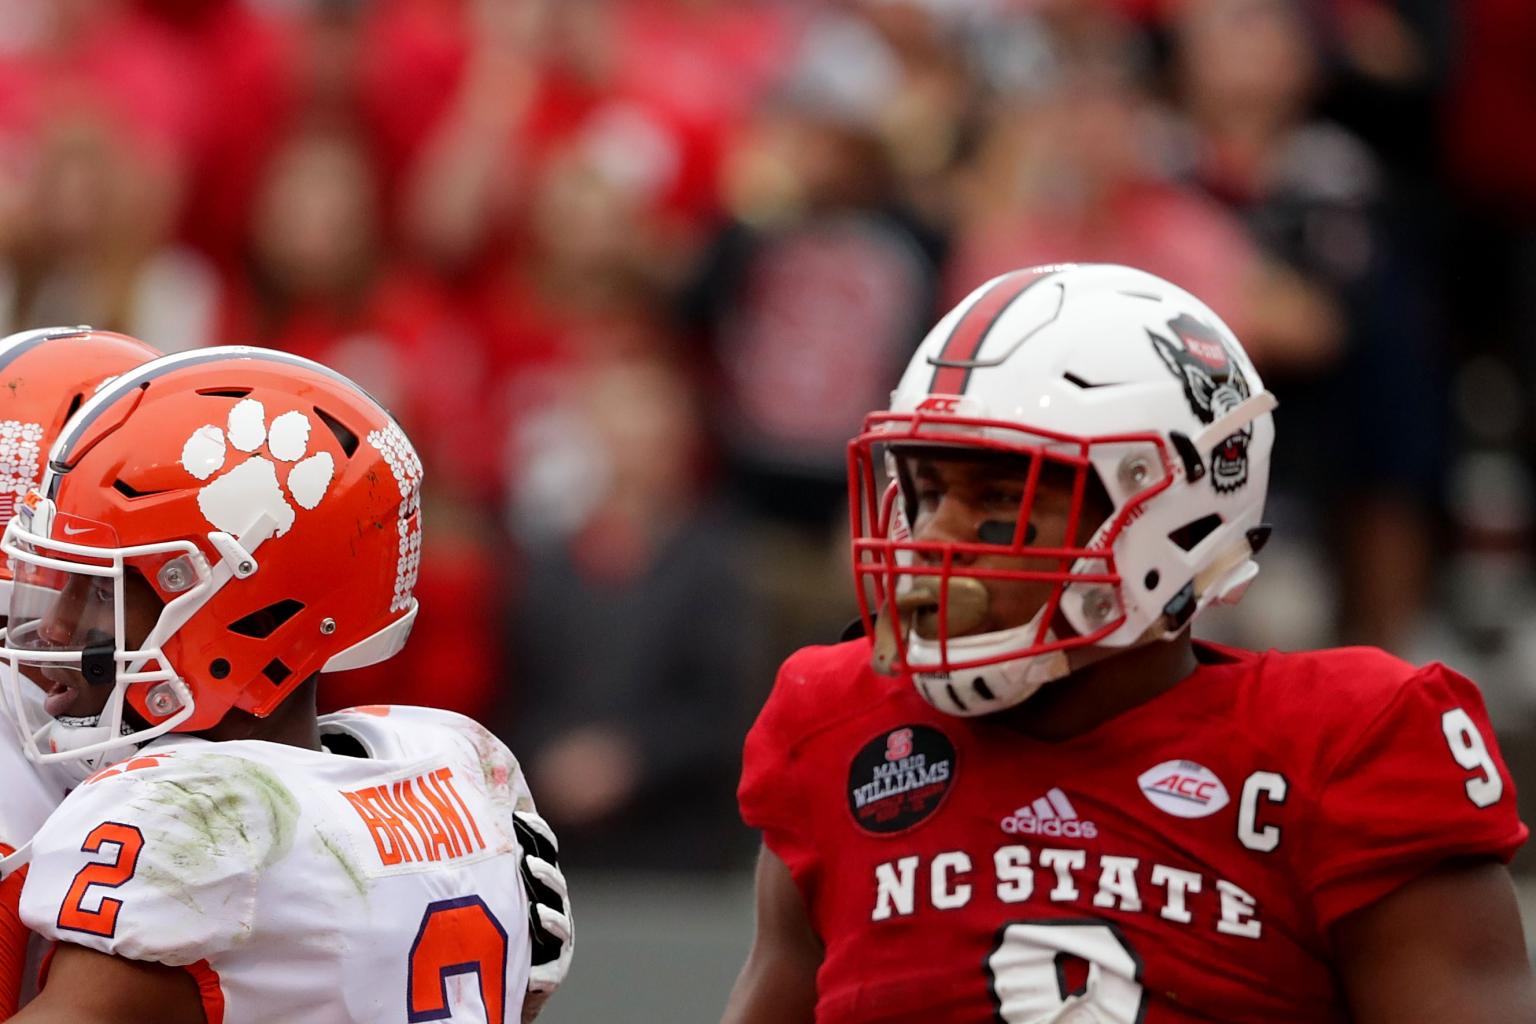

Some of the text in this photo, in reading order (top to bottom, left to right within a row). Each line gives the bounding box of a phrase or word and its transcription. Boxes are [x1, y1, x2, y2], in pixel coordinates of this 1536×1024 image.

[853, 759, 950, 808] WILLIAMS
[873, 753, 926, 780] MARIO
[1154, 774, 1218, 802] ACC
[1441, 705, 1504, 810] 9
[340, 766, 487, 867] BRYANT
[1000, 812, 1098, 839] adidas
[1237, 769, 1289, 853] C
[56, 821, 145, 938] 2
[871, 844, 1263, 940] NC STATE
